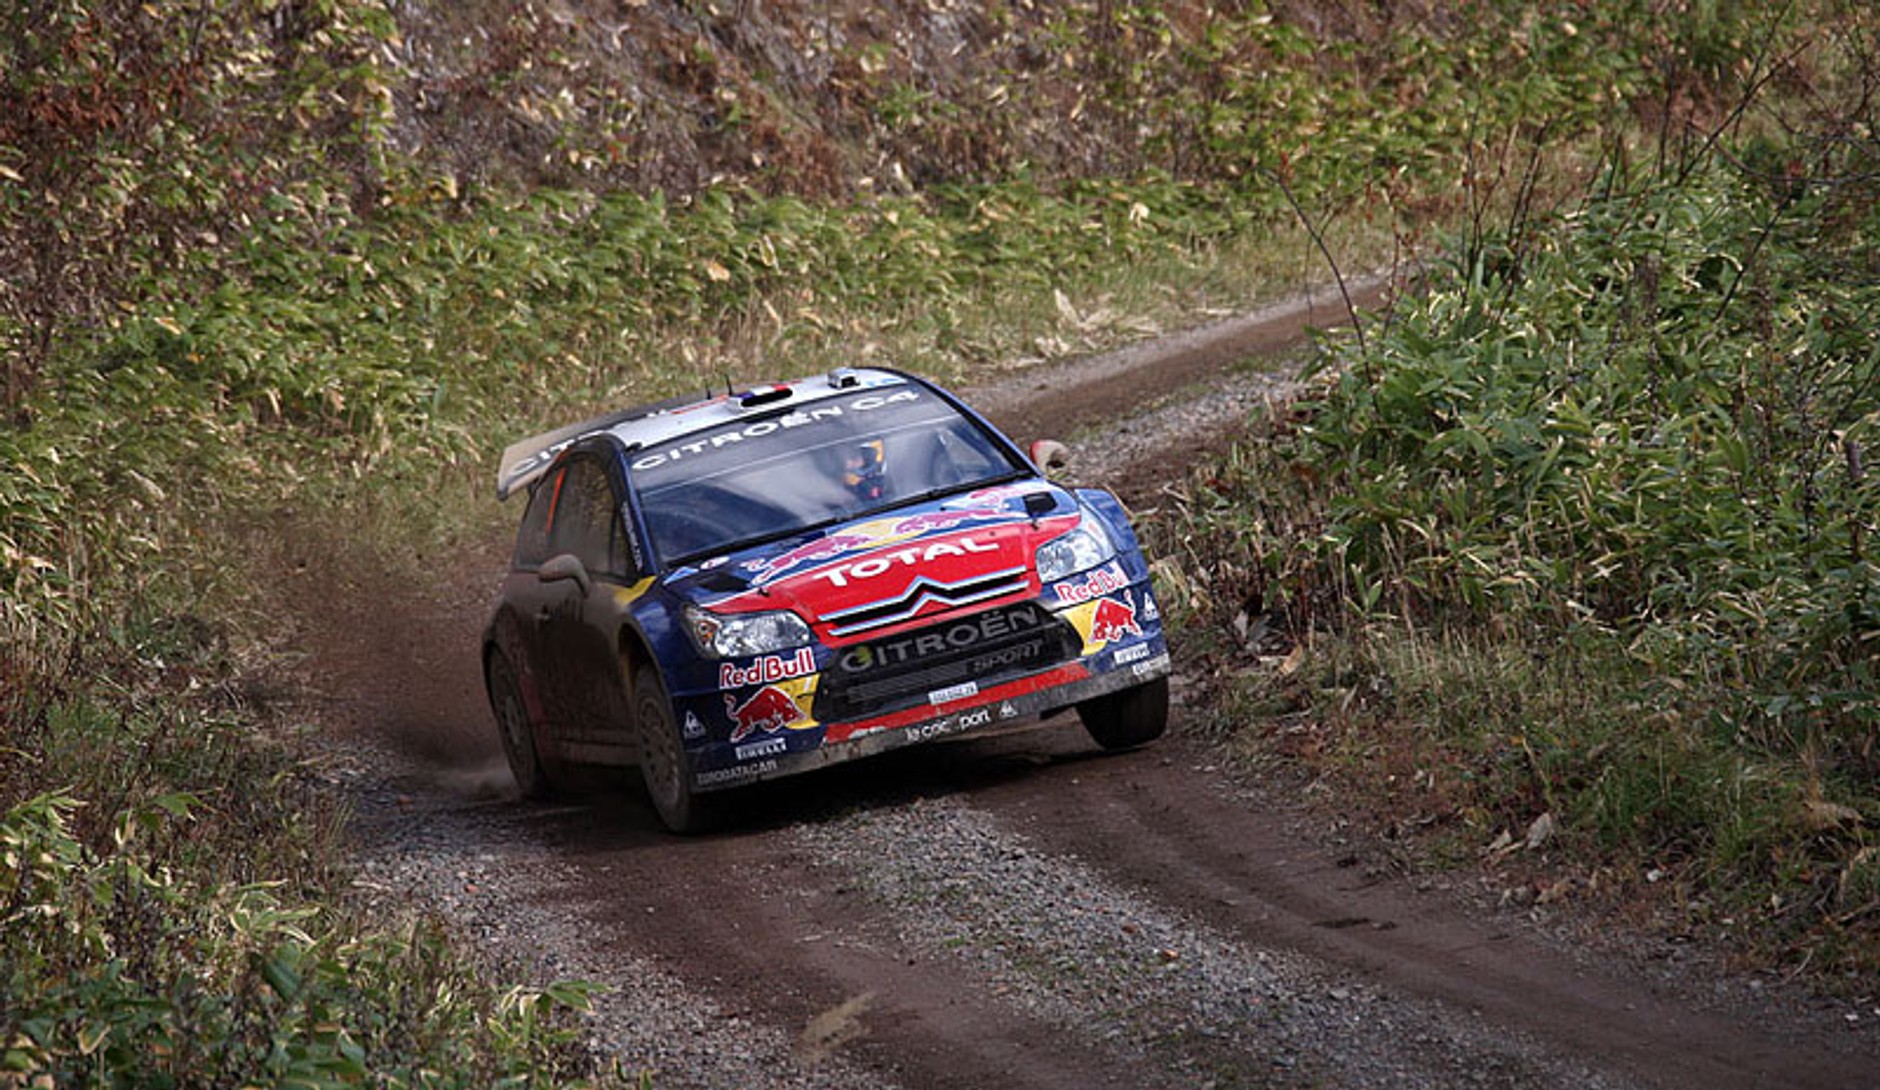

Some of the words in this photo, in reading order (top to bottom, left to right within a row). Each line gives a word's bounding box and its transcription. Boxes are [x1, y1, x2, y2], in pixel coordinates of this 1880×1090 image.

[632, 405, 843, 470] CITROËN
[850, 390, 920, 411] C4
[812, 537, 1000, 588] TOTAL
[1053, 571, 1105, 604] Red
[840, 604, 1040, 673] CITROËN
[973, 637, 1045, 674] SPORT
[719, 656, 763, 690] Red
[763, 646, 817, 682] Bull
[957, 709, 992, 730] port
